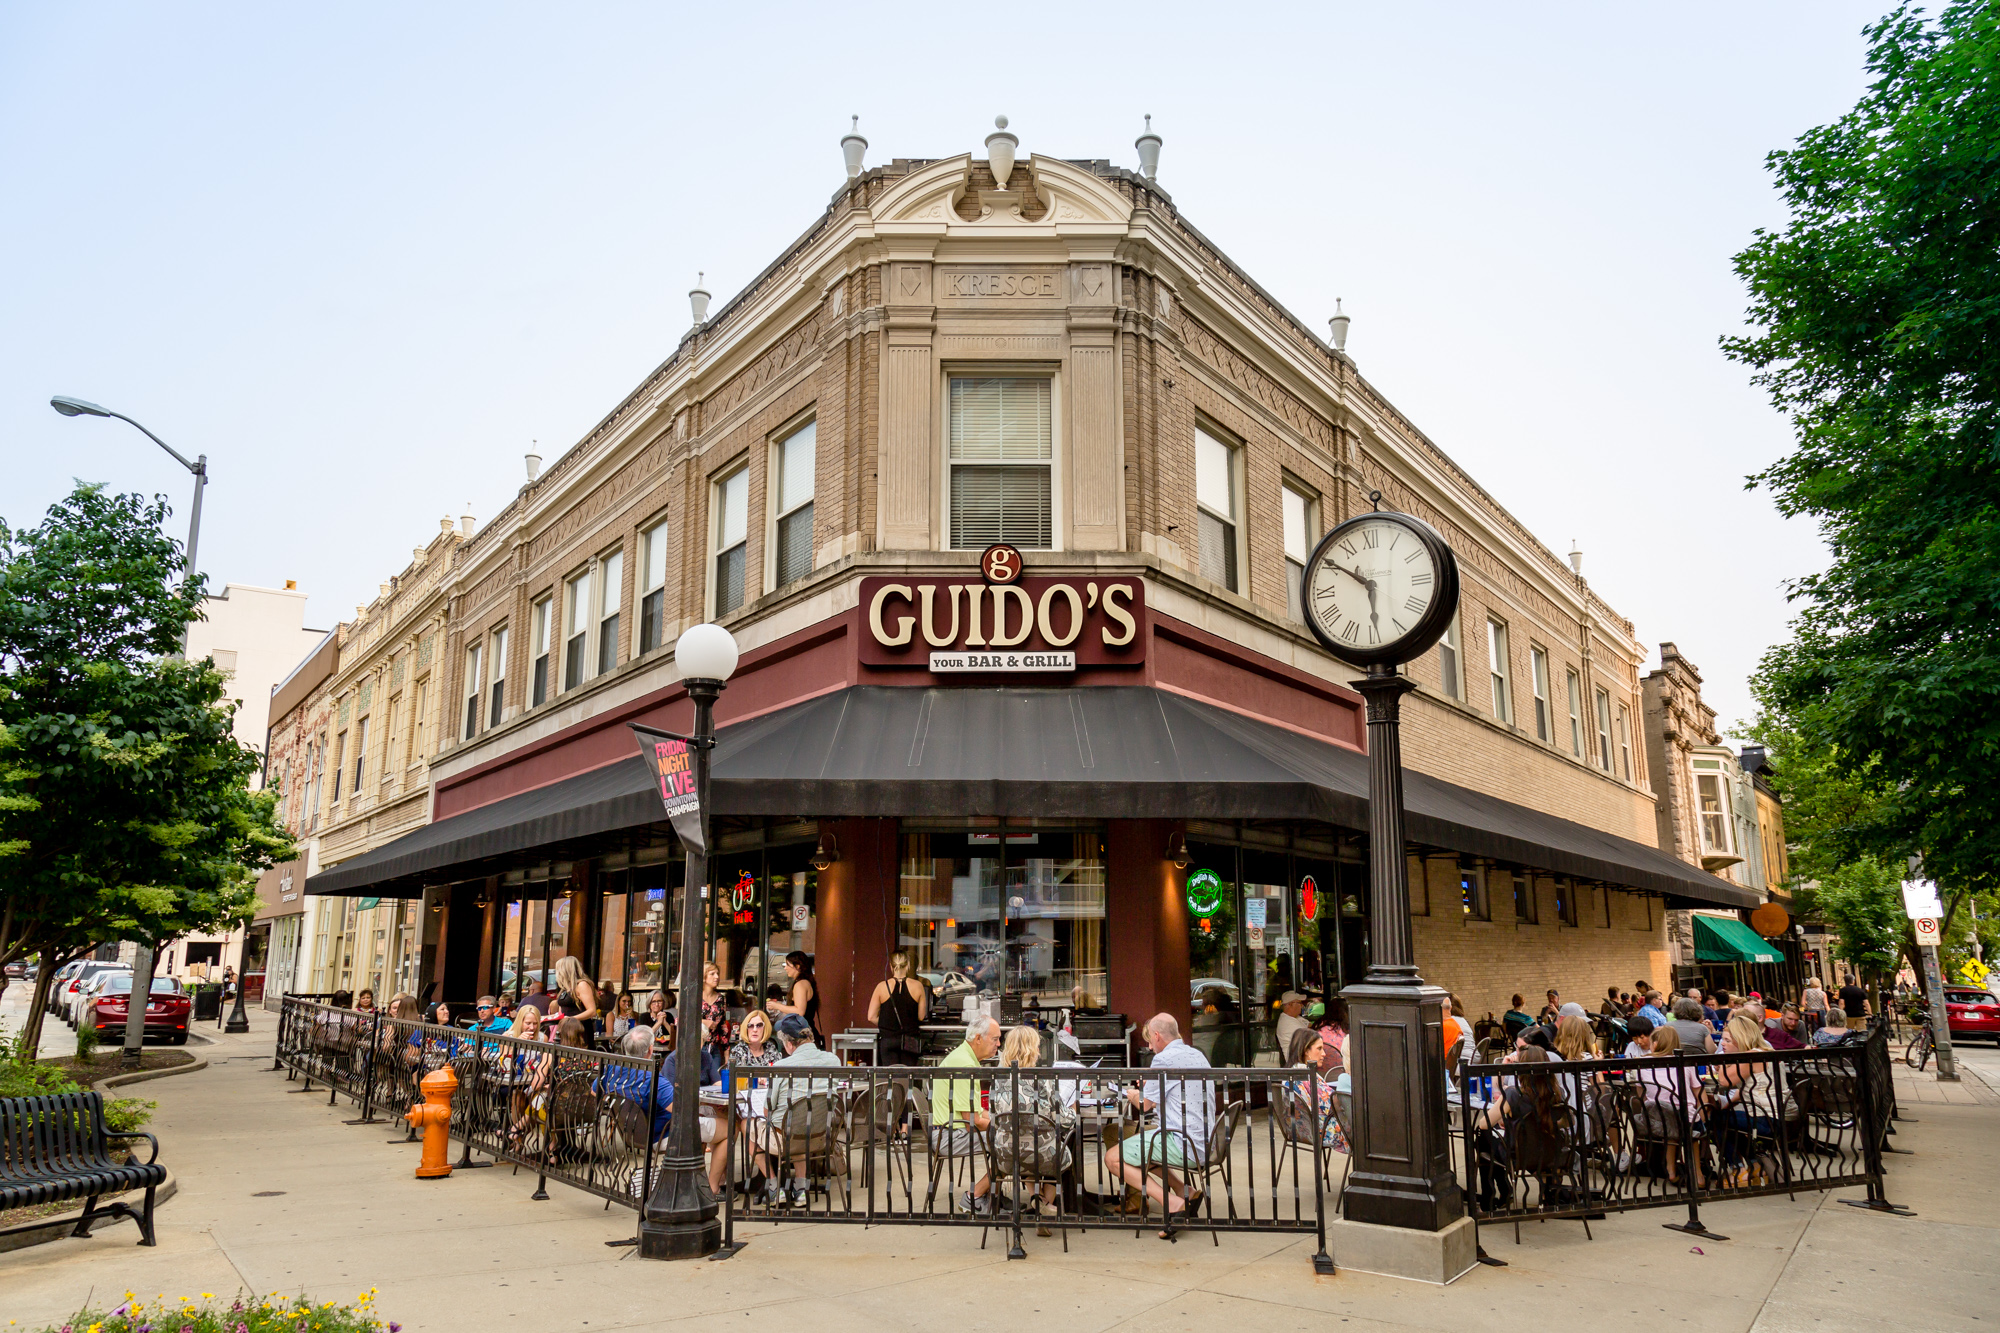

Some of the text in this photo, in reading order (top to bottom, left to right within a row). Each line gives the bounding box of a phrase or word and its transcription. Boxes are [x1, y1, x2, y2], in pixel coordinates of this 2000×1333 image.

[948, 275, 1055, 296] KRESGE
[989, 549, 1015, 581] g
[869, 582, 1137, 647] GUIDO'S
[933, 655, 1072, 668] YOUR BAR & GRILL
[655, 738, 688, 758] FRIDAY
[657, 752, 690, 776] NIGHT
[660, 770, 696, 799] LIVE
[663, 792, 698, 809] DOWNTOWN
[666, 801, 700, 817] CHAMPAIGN
